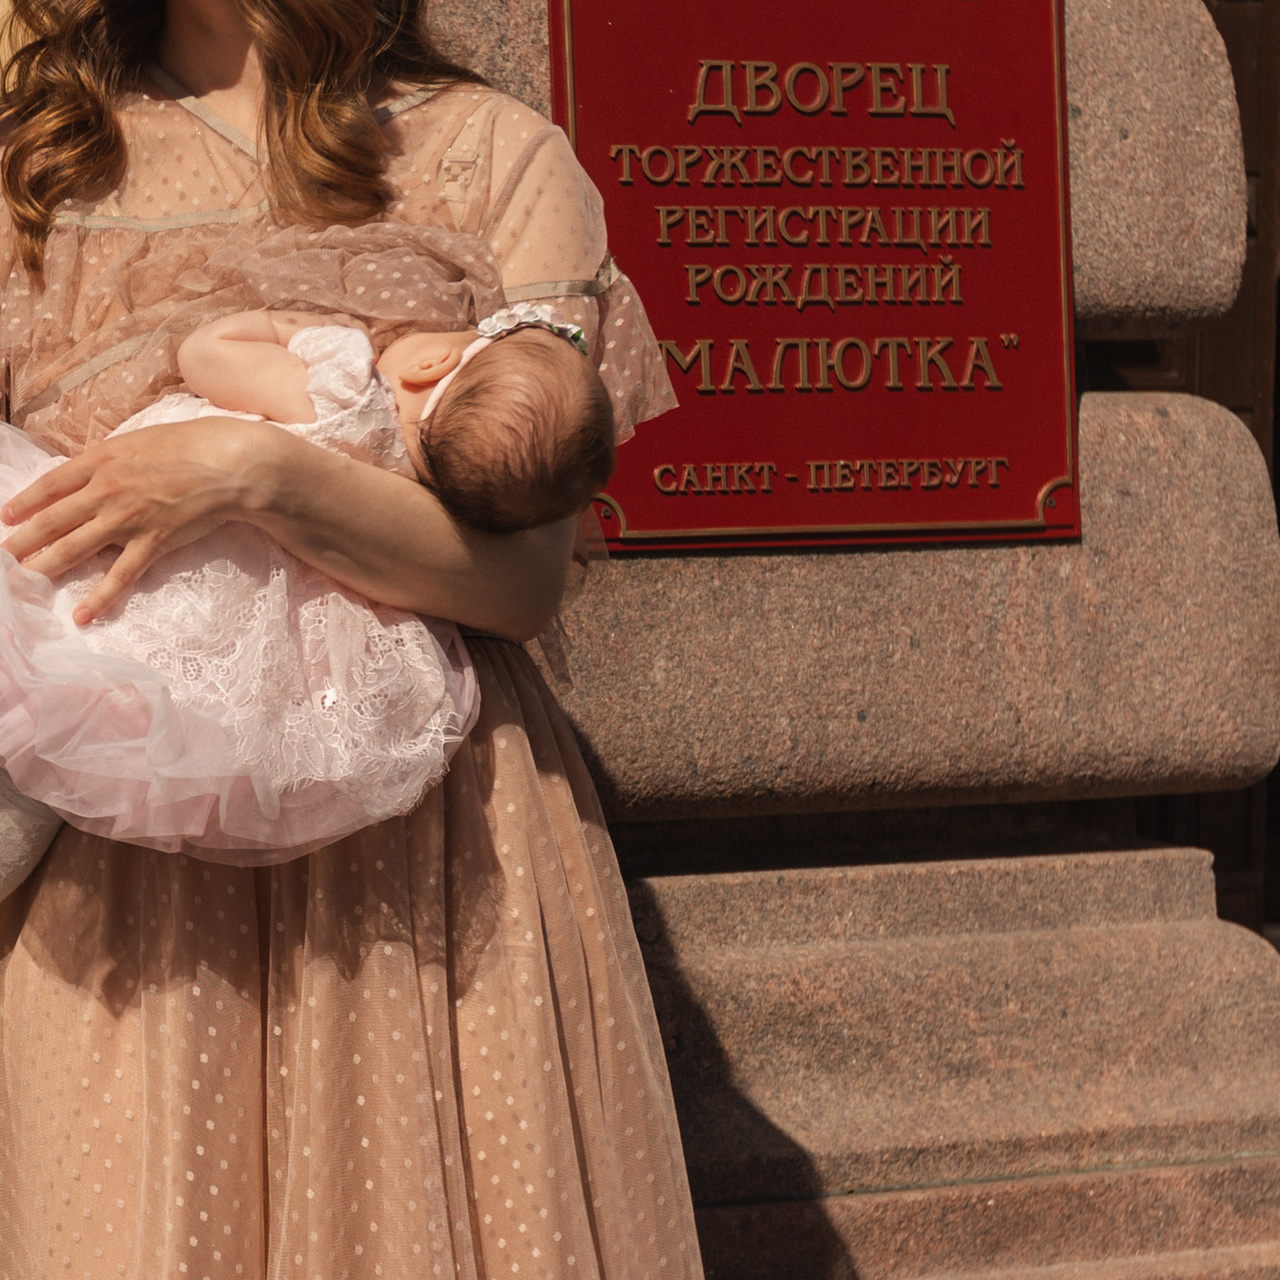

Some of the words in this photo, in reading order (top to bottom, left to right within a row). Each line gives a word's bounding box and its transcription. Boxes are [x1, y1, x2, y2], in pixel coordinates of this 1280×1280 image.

[687, 60, 955, 127] ДВОРЕЦ
[610, 139, 1025, 188] ТОРЖЕСТВЕННОЙ
[655, 205, 992, 253] РЕГИСТРАЦИИ
[684, 255, 963, 310] РОЖДЕНИЙ
